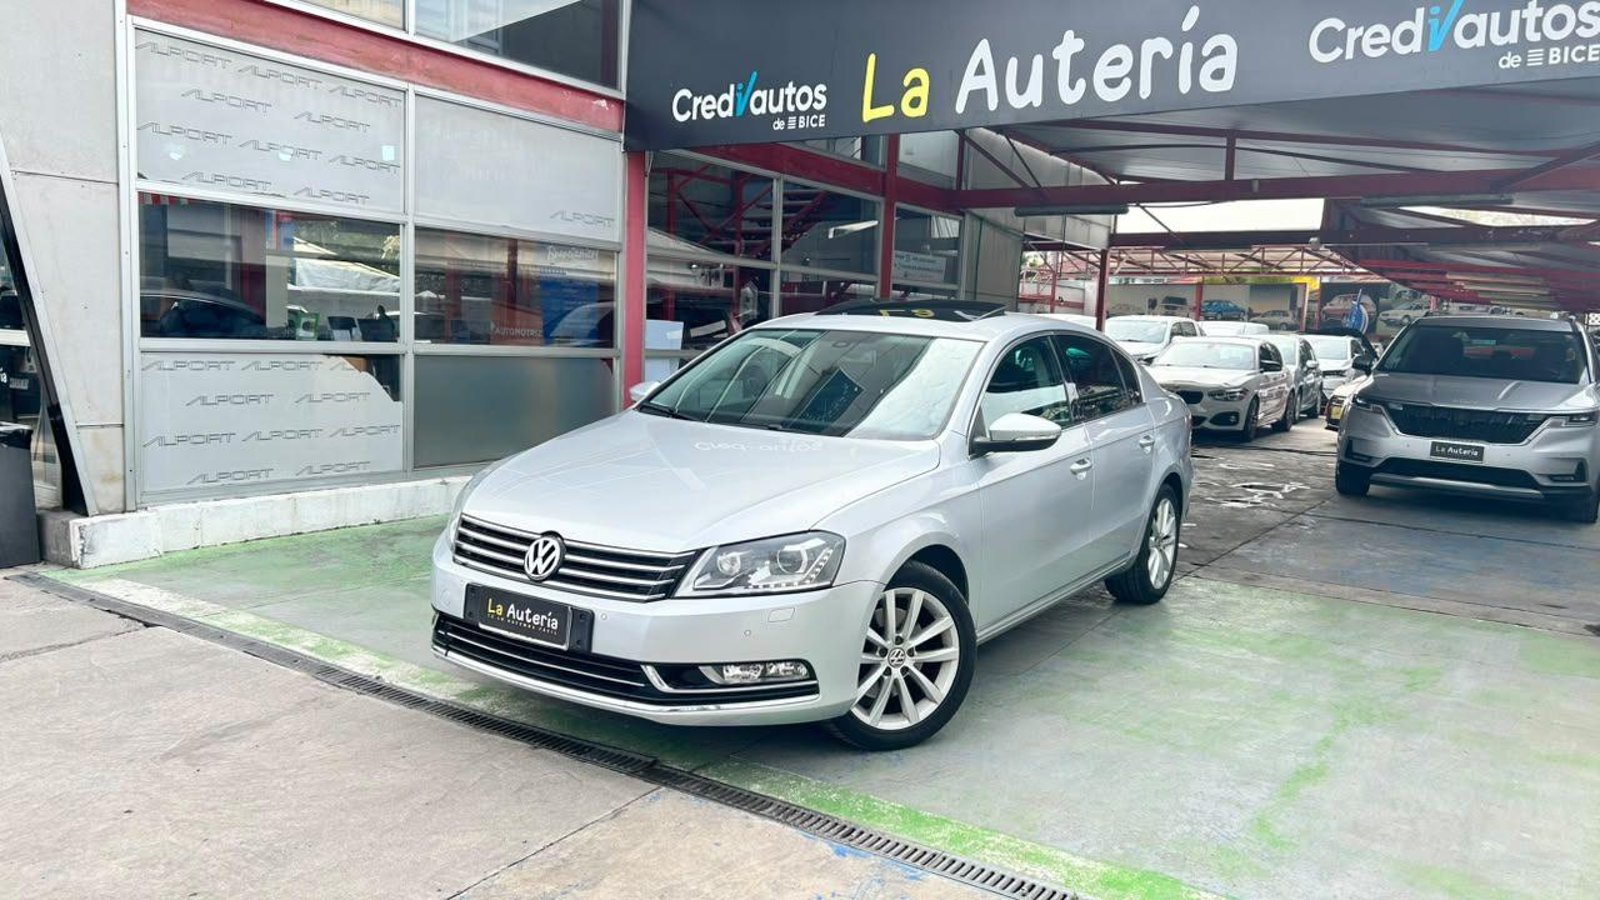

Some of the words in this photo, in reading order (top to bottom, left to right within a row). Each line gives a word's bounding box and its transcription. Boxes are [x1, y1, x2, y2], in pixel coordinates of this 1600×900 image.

[862, 53, 930, 123] La
[955, 5, 1238, 114] Autería
[1499, 51, 1522, 69] de
[1548, 45, 1600, 65] BICE
[772, 117, 785, 131] de
[798, 114, 826, 129] BICE
[487, 598, 504, 616] La
[506, 603, 559, 630] Autería
